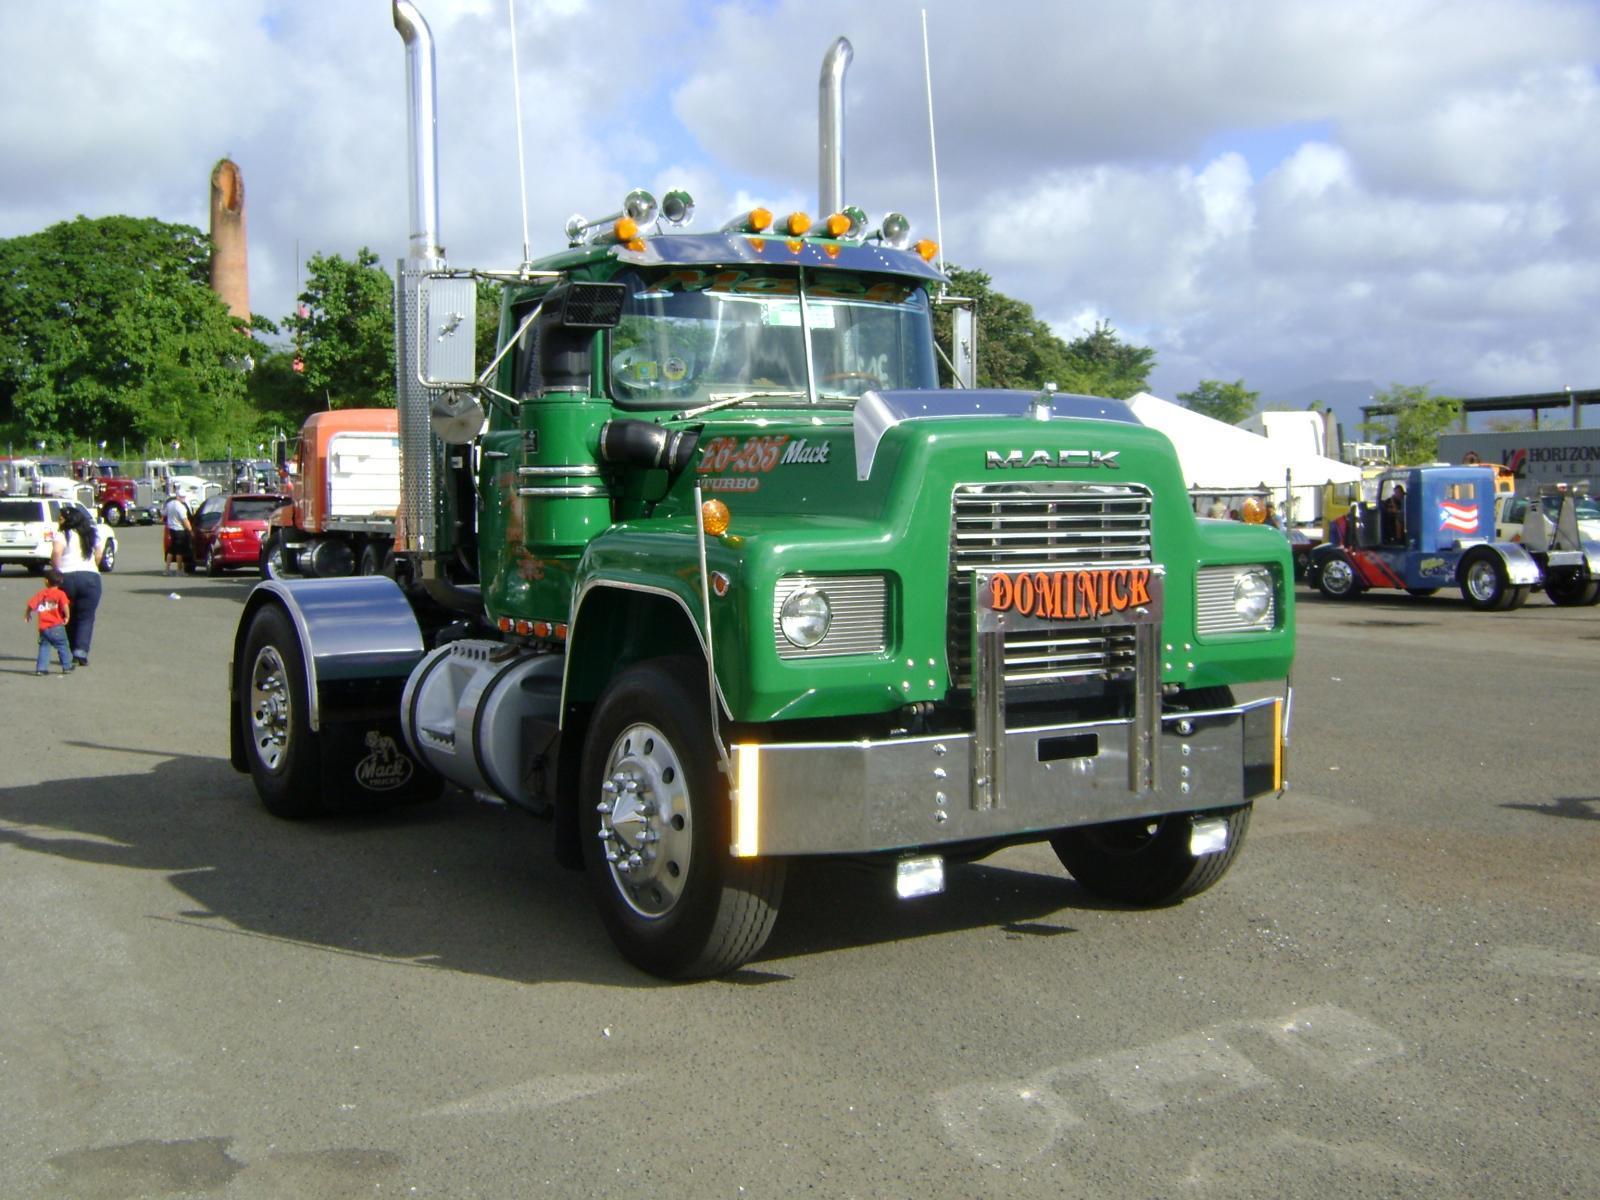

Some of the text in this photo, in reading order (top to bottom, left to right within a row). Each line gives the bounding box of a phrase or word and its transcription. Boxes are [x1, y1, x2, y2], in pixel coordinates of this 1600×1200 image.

[780, 438, 831, 464] Mack
[985, 449, 1121, 470] MACK
[1529, 446, 1600, 462] HORIZON
[1527, 463, 1592, 473] LINES
[700, 477, 760, 492] TURBO
[990, 569, 1153, 621] DOMINICK
[361, 758, 405, 779] Mack
